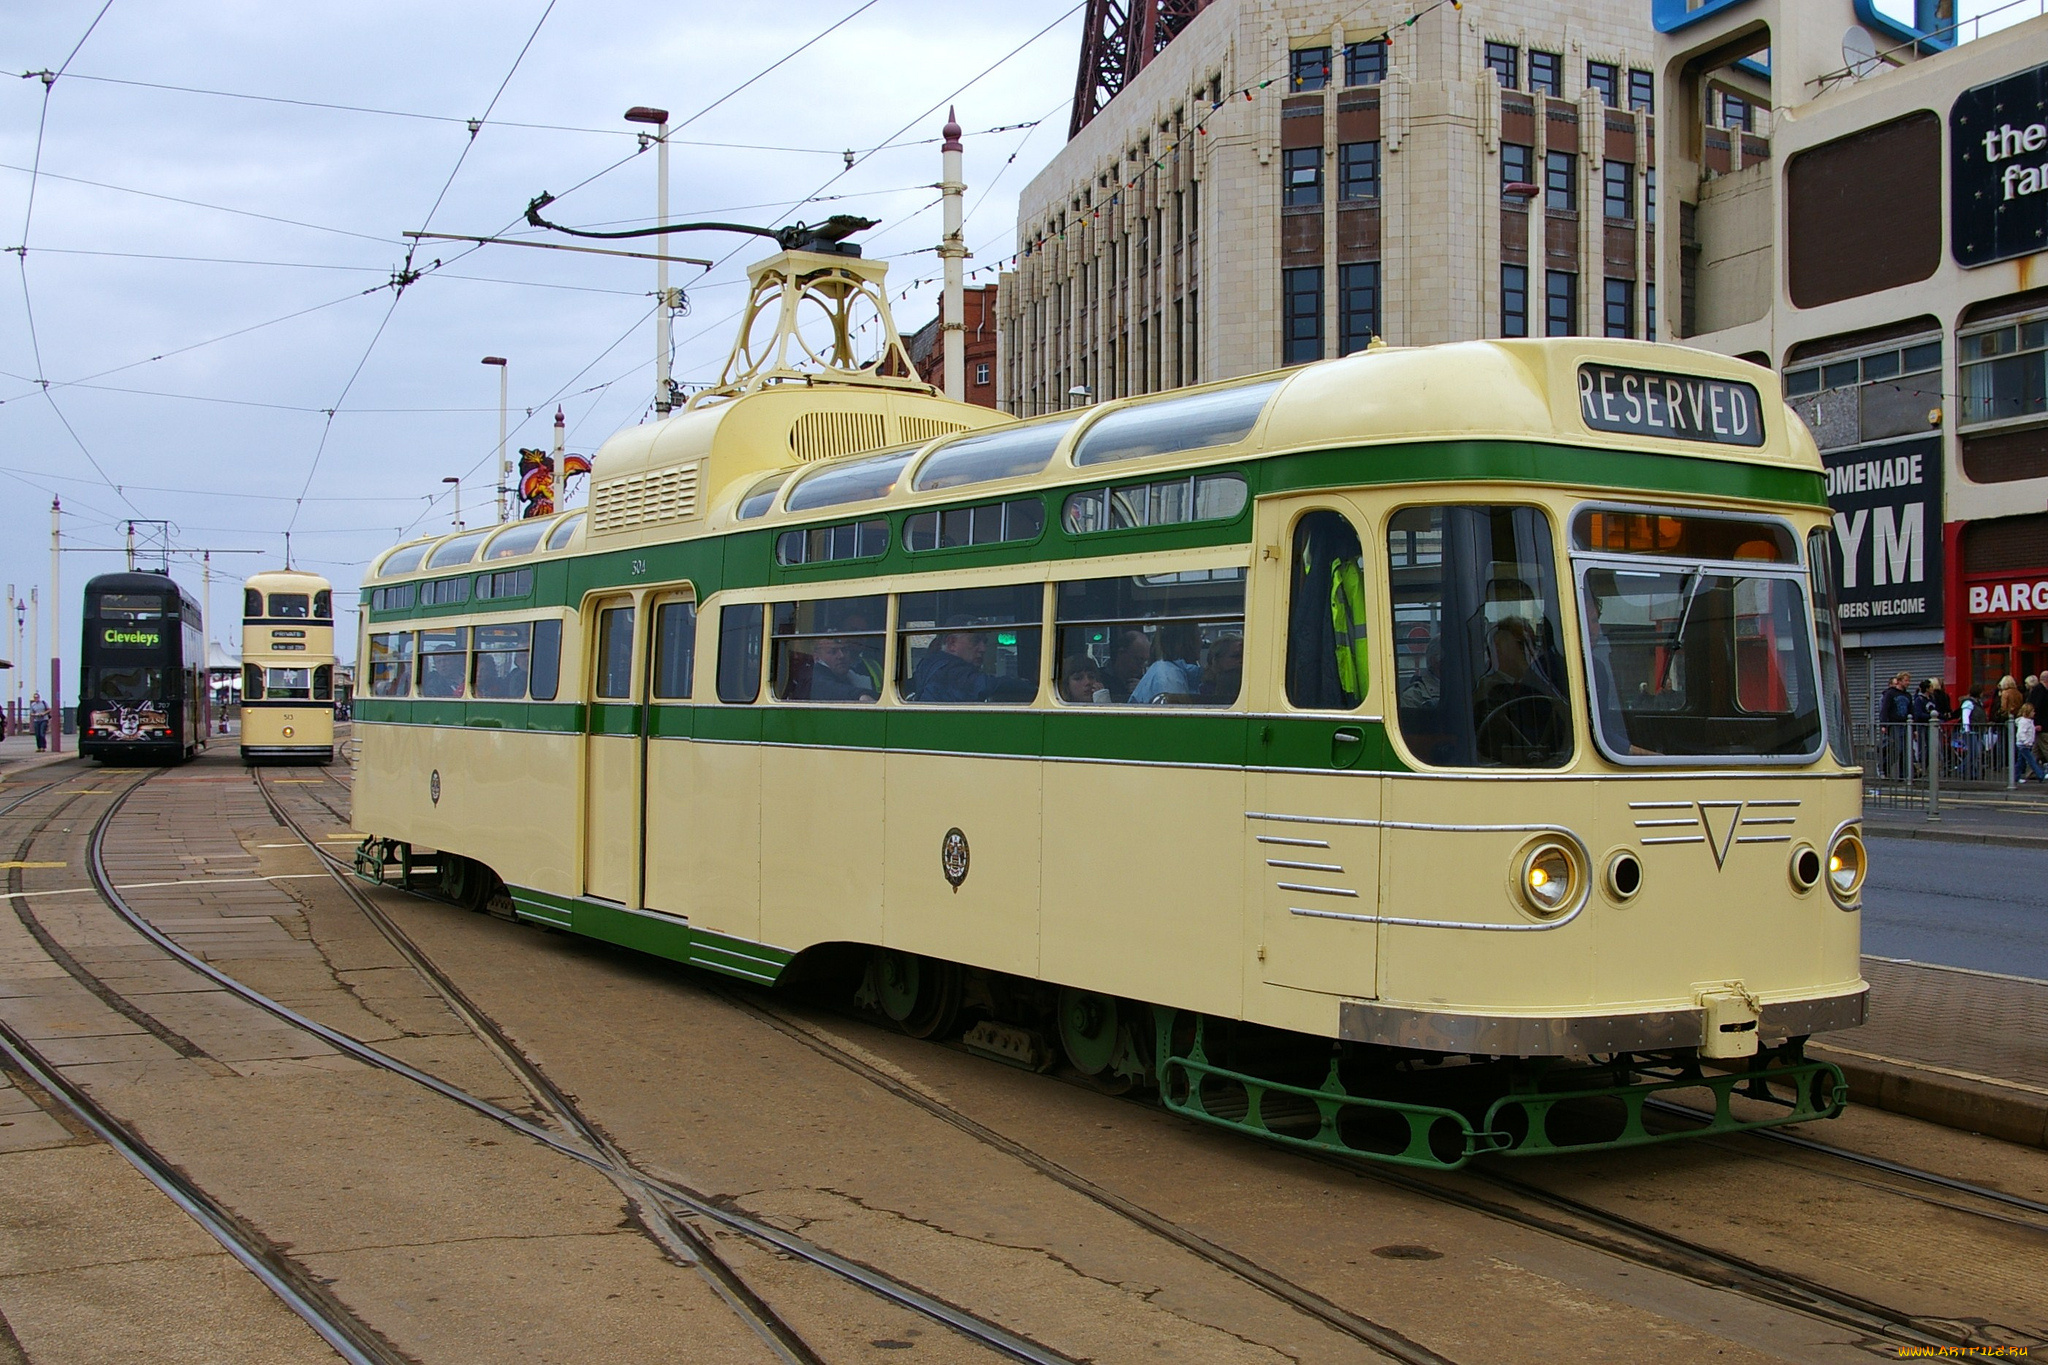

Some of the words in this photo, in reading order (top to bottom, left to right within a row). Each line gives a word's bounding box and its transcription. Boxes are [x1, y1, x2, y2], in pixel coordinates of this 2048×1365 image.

[1981, 123, 2047, 162] the
[1578, 368, 1749, 436] RESERVED
[1824, 454, 1923, 497] OMENADE
[1832, 502, 1925, 588] YM
[631, 559, 646, 576] 304
[1871, 597, 1926, 617] WELCOME
[1968, 581, 2048, 614] BARG
[104, 629, 159, 647] Cleveleys
[283, 713, 294, 721] 513
